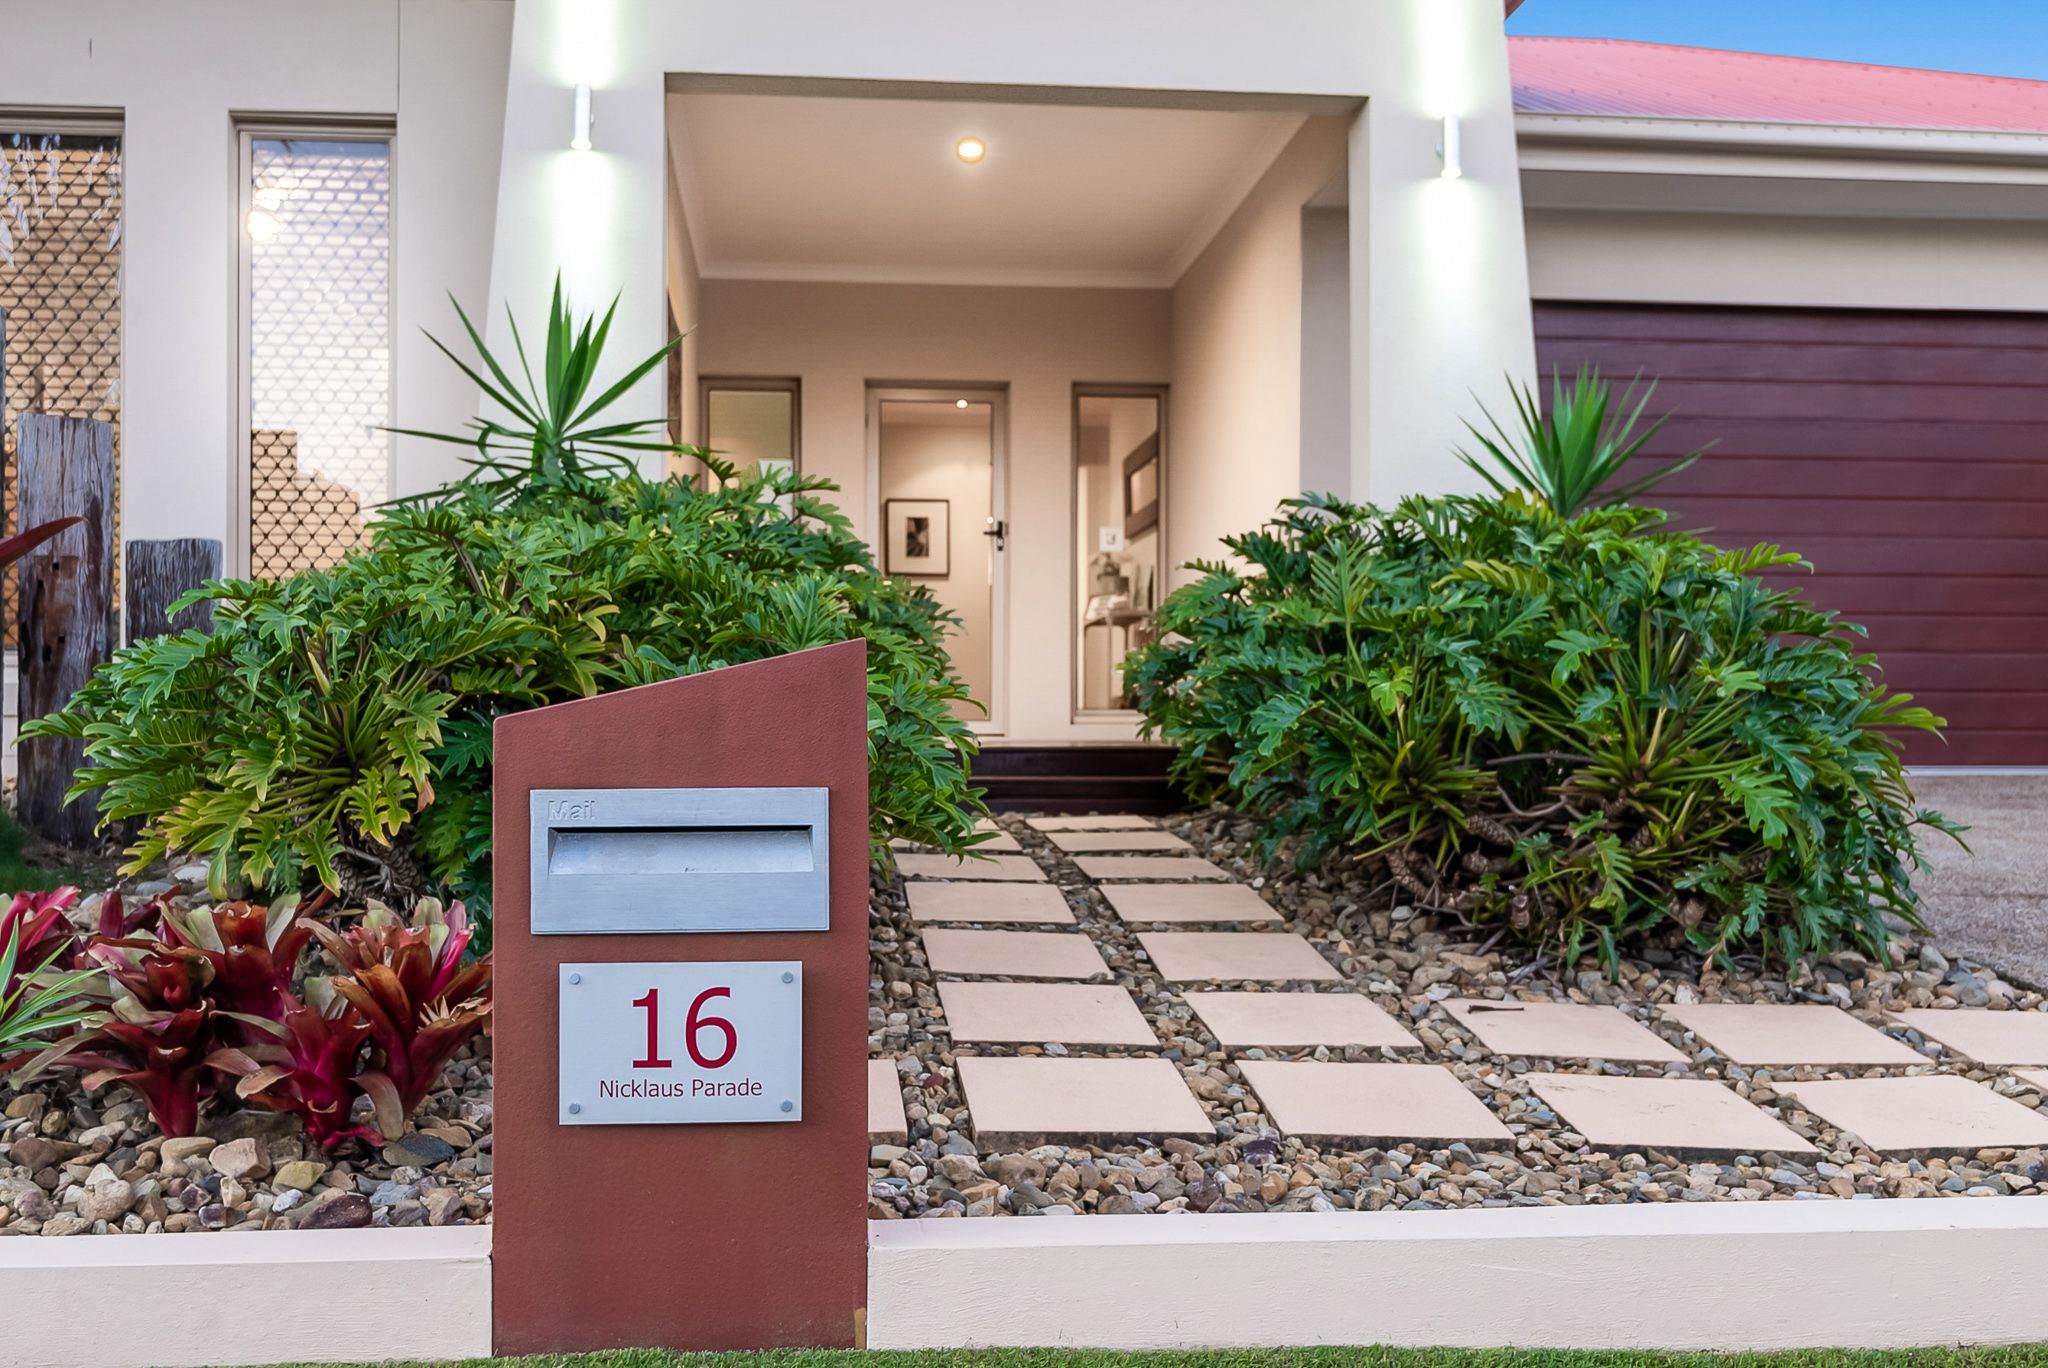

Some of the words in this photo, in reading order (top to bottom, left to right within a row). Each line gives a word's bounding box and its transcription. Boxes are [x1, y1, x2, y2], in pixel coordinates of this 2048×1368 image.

[548, 800, 595, 820] Mail
[632, 987, 737, 1069] 16
[599, 1079, 684, 1099] Nicklaus
[692, 1078, 763, 1097] Parade
